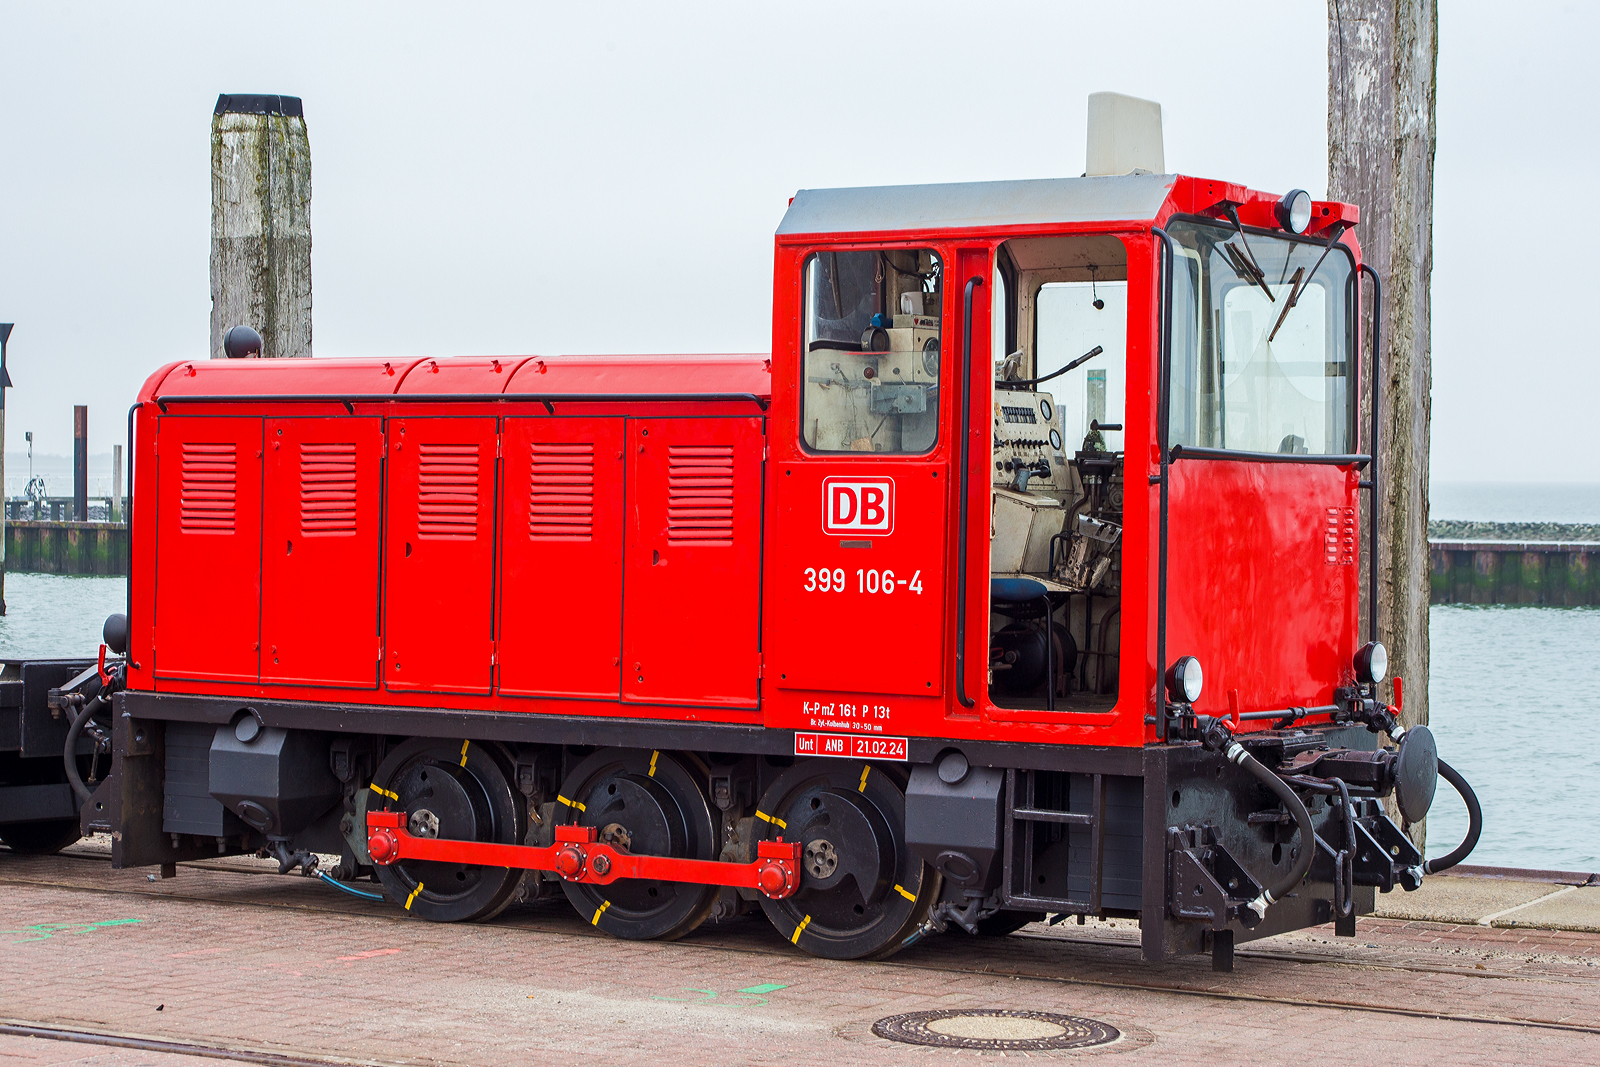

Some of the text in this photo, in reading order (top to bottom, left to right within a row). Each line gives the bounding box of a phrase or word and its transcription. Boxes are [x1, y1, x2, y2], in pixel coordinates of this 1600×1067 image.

[832, 486, 885, 525] DB
[803, 567, 923, 595] 399 106-4
[862, 704, 869, 718] P
[873, 705, 890, 719] 13t
[799, 737, 904, 755] Unt ANB 21.02.24
